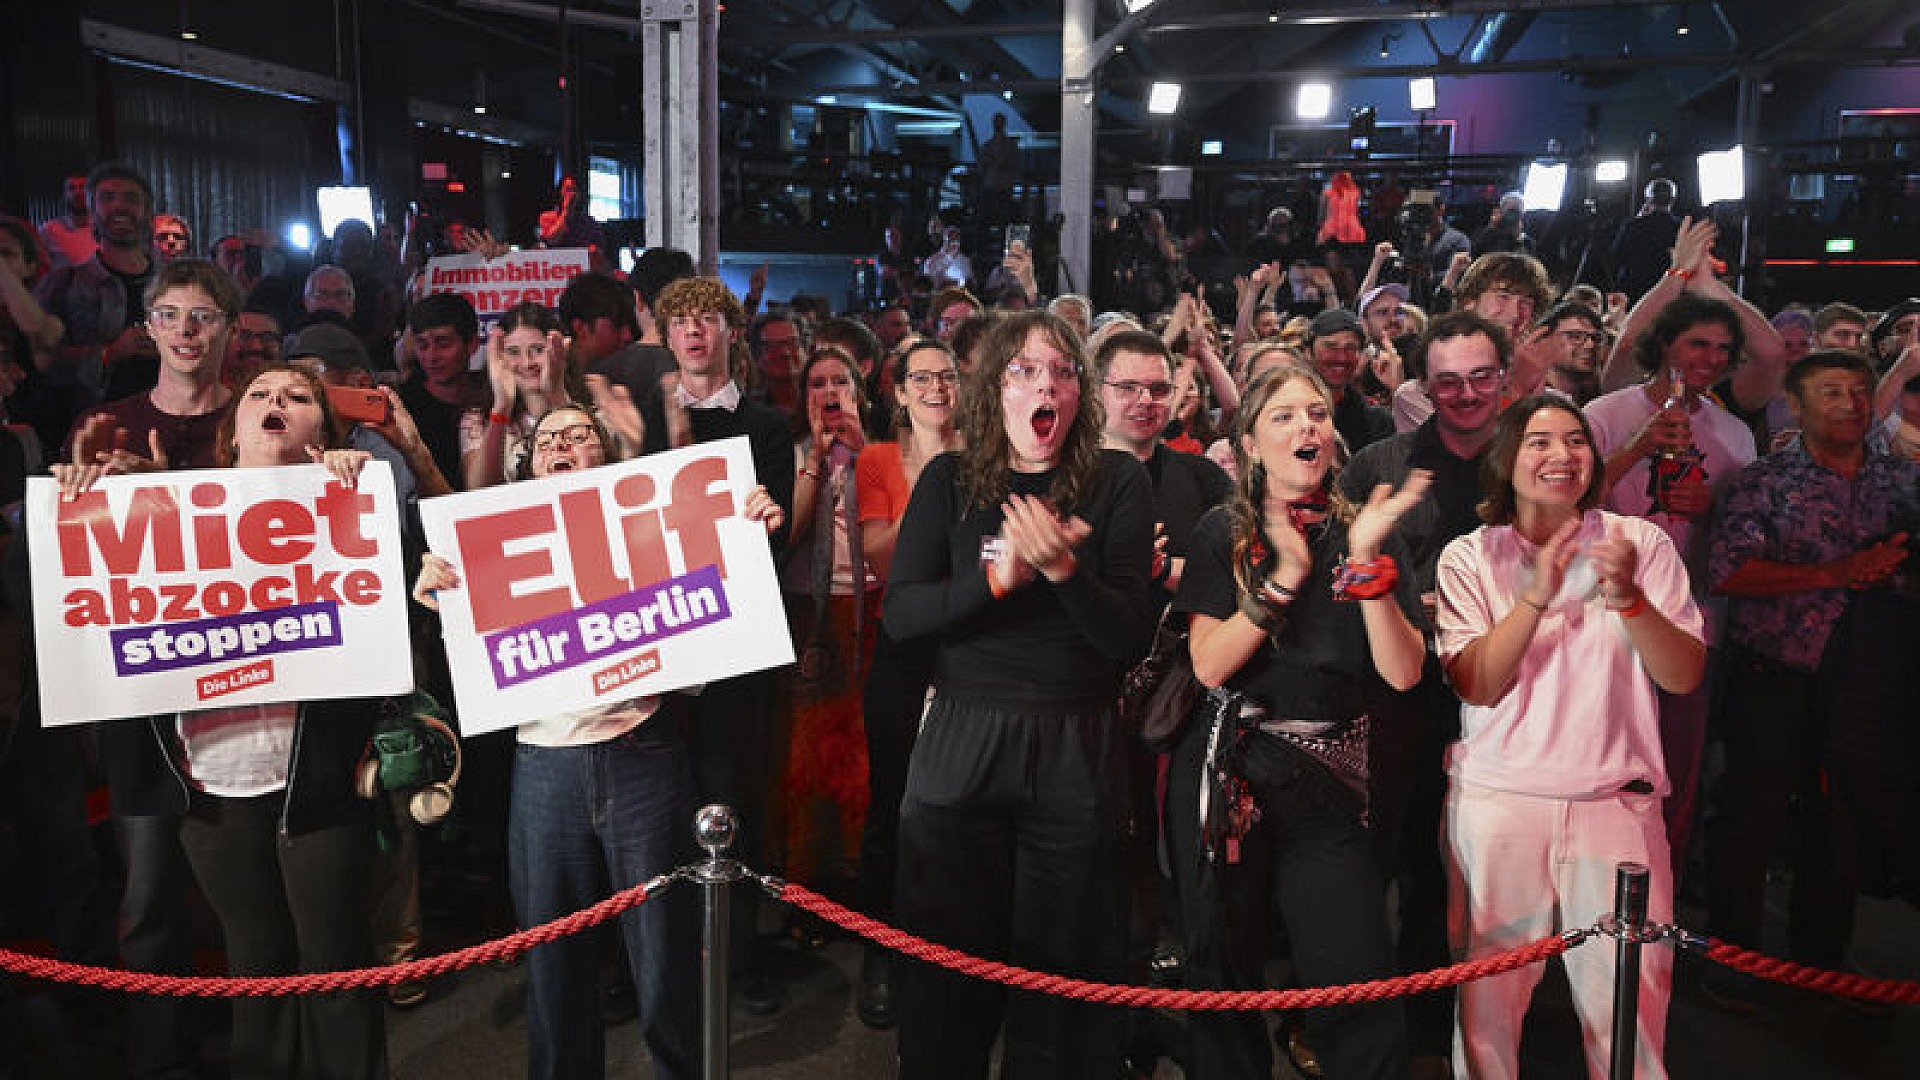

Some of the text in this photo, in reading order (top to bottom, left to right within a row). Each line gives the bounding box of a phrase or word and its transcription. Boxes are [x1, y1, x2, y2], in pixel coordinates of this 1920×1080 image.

[432, 261, 582, 285] Immobilien
[57, 481, 380, 577] Miet
[454, 456, 735, 634] Elif
[63, 564, 382, 627] abzocke
[121, 610, 332, 665] stoppen
[496, 585, 720, 678] für Berlin
[204, 669, 270, 695] Die Linke
